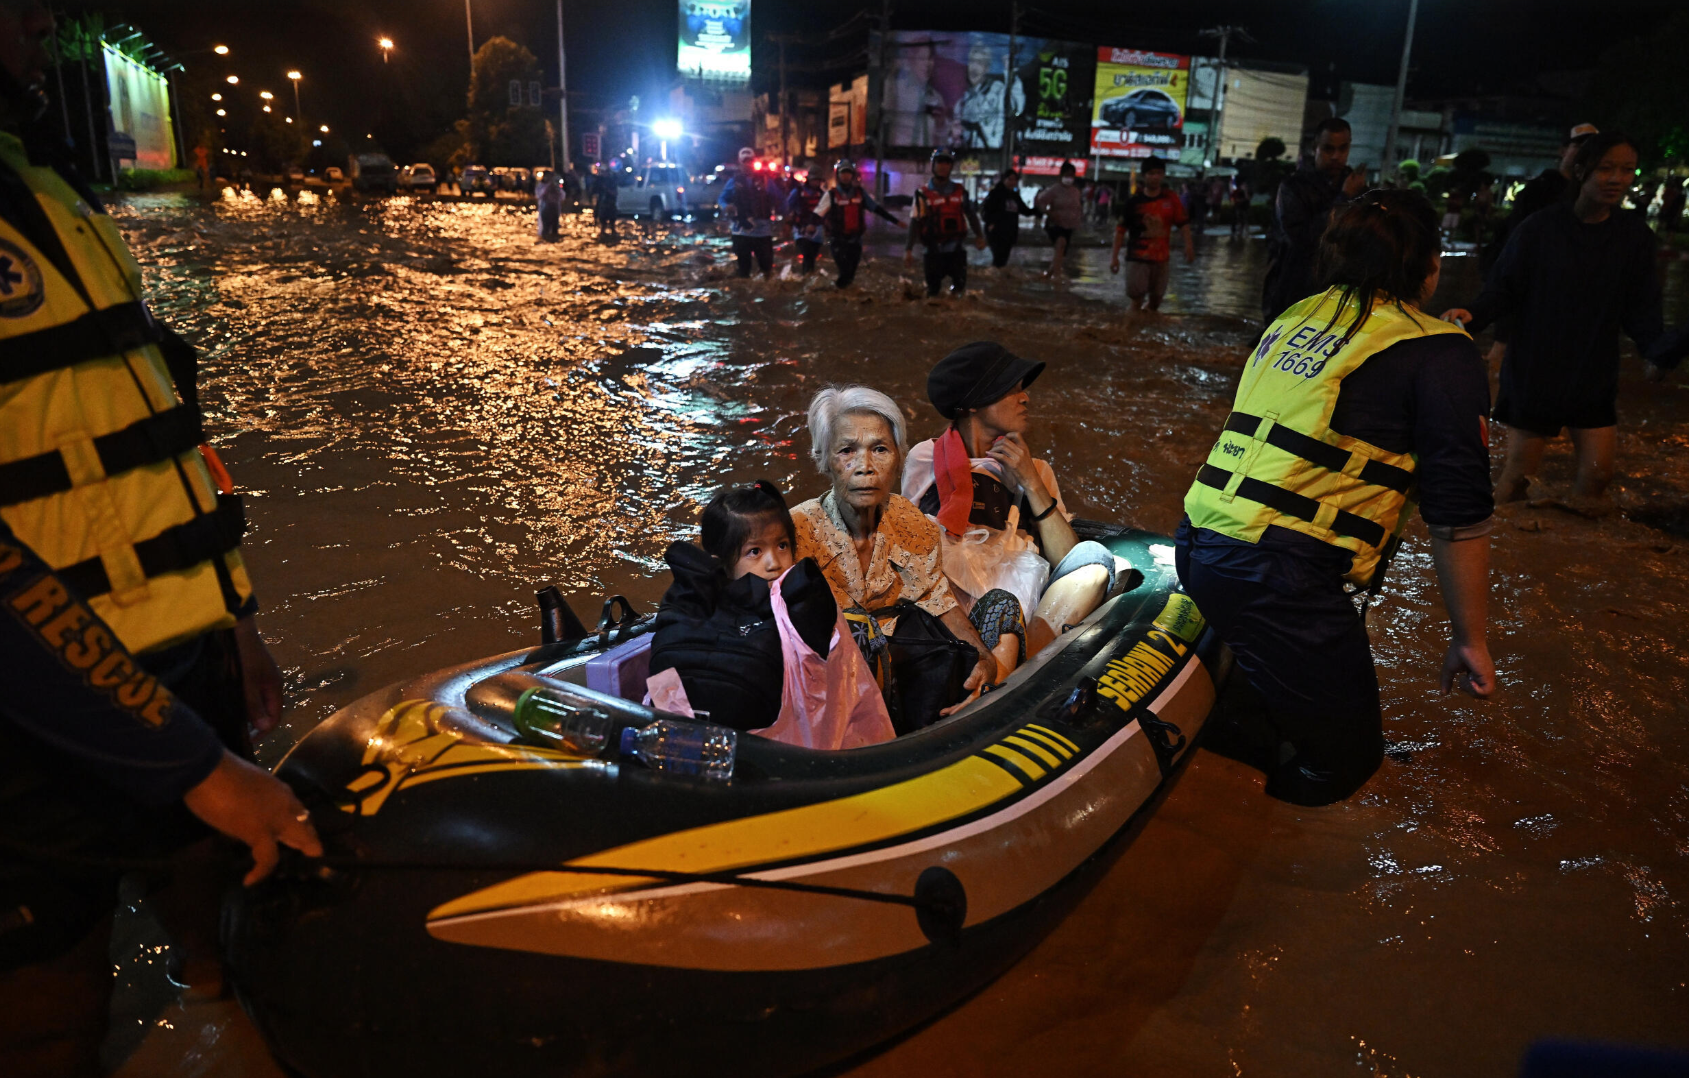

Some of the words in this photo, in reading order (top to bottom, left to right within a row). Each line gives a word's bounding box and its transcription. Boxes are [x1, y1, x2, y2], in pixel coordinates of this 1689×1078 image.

[1039, 67, 1068, 99] 5G
[1286, 326, 1350, 358] EMS
[1272, 350, 1327, 379] 1669
[8, 574, 173, 728] RESCUE
[1096, 640, 1176, 712] SEAHAWK
[1146, 629, 1188, 658] 2
